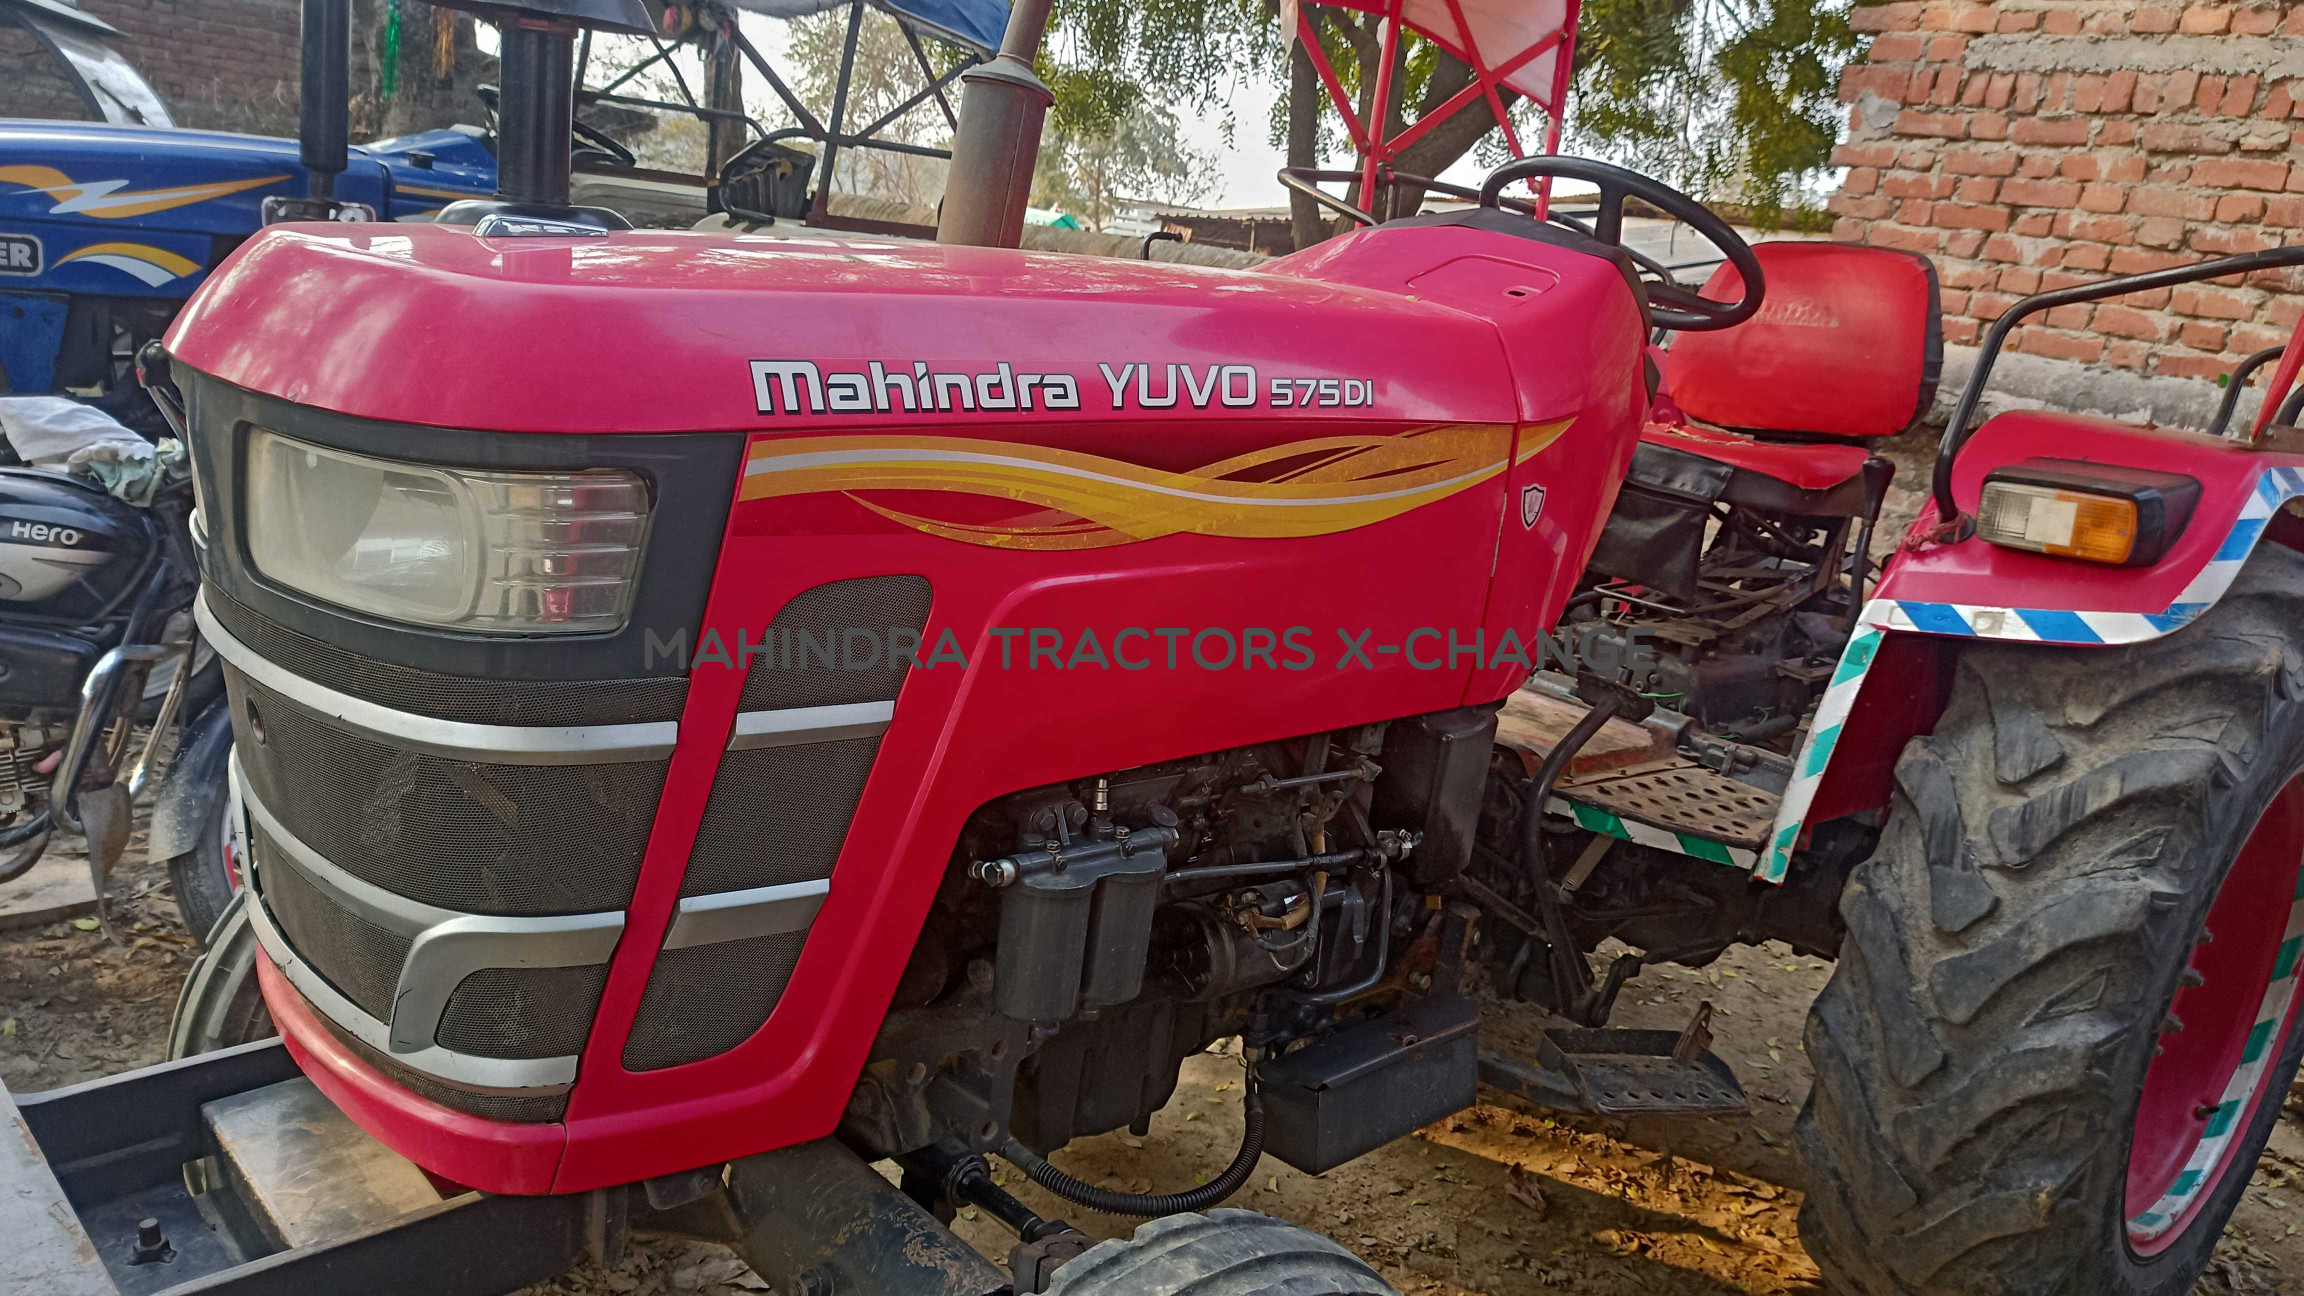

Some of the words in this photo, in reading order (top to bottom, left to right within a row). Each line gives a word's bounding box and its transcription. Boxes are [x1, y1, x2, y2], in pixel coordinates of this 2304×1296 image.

[749, 360, 1081, 413] Mahindra
[1099, 363, 1257, 408] YUVO
[1270, 378, 1374, 408] 575DI
[12, 521, 79, 546] Hero
